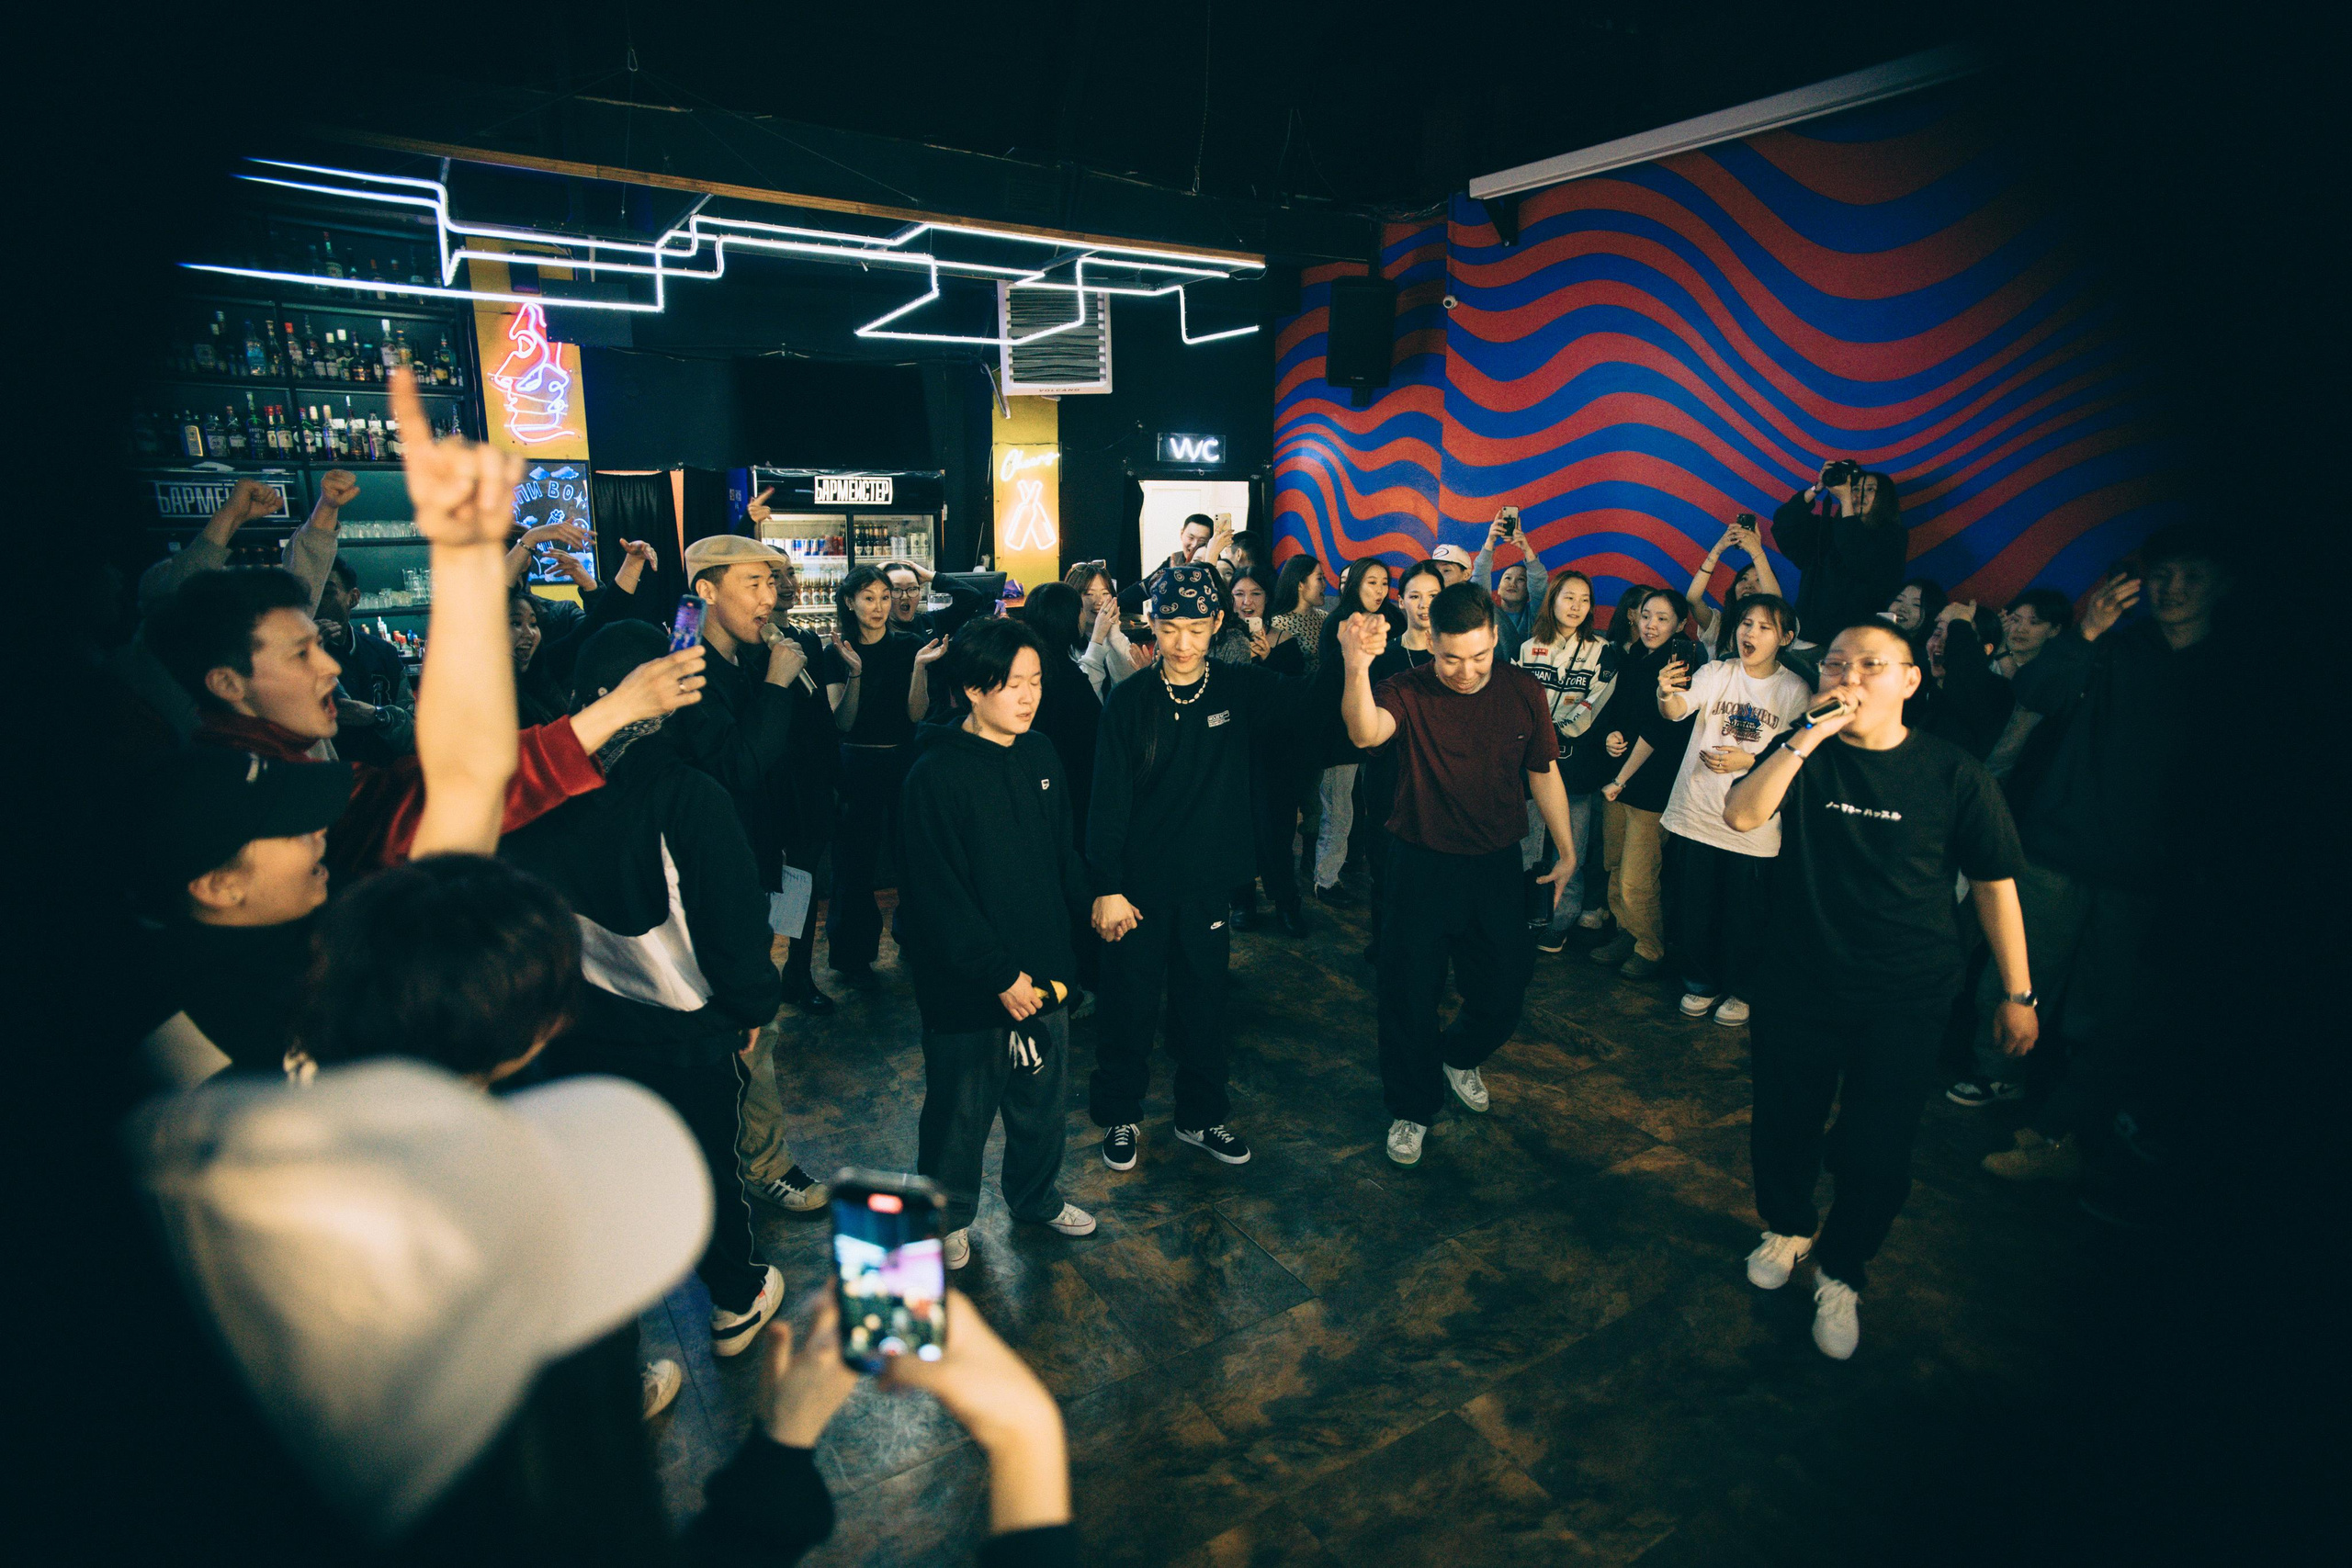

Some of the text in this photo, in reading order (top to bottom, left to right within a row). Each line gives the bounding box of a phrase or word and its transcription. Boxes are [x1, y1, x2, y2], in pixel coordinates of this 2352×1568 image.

[1170, 437, 1220, 462] WC
[513, 480, 574, 504] ПИВО
[815, 476, 891, 502] БАРМЕЙСТЕР
[1750, 706, 1780, 729] FIELD
